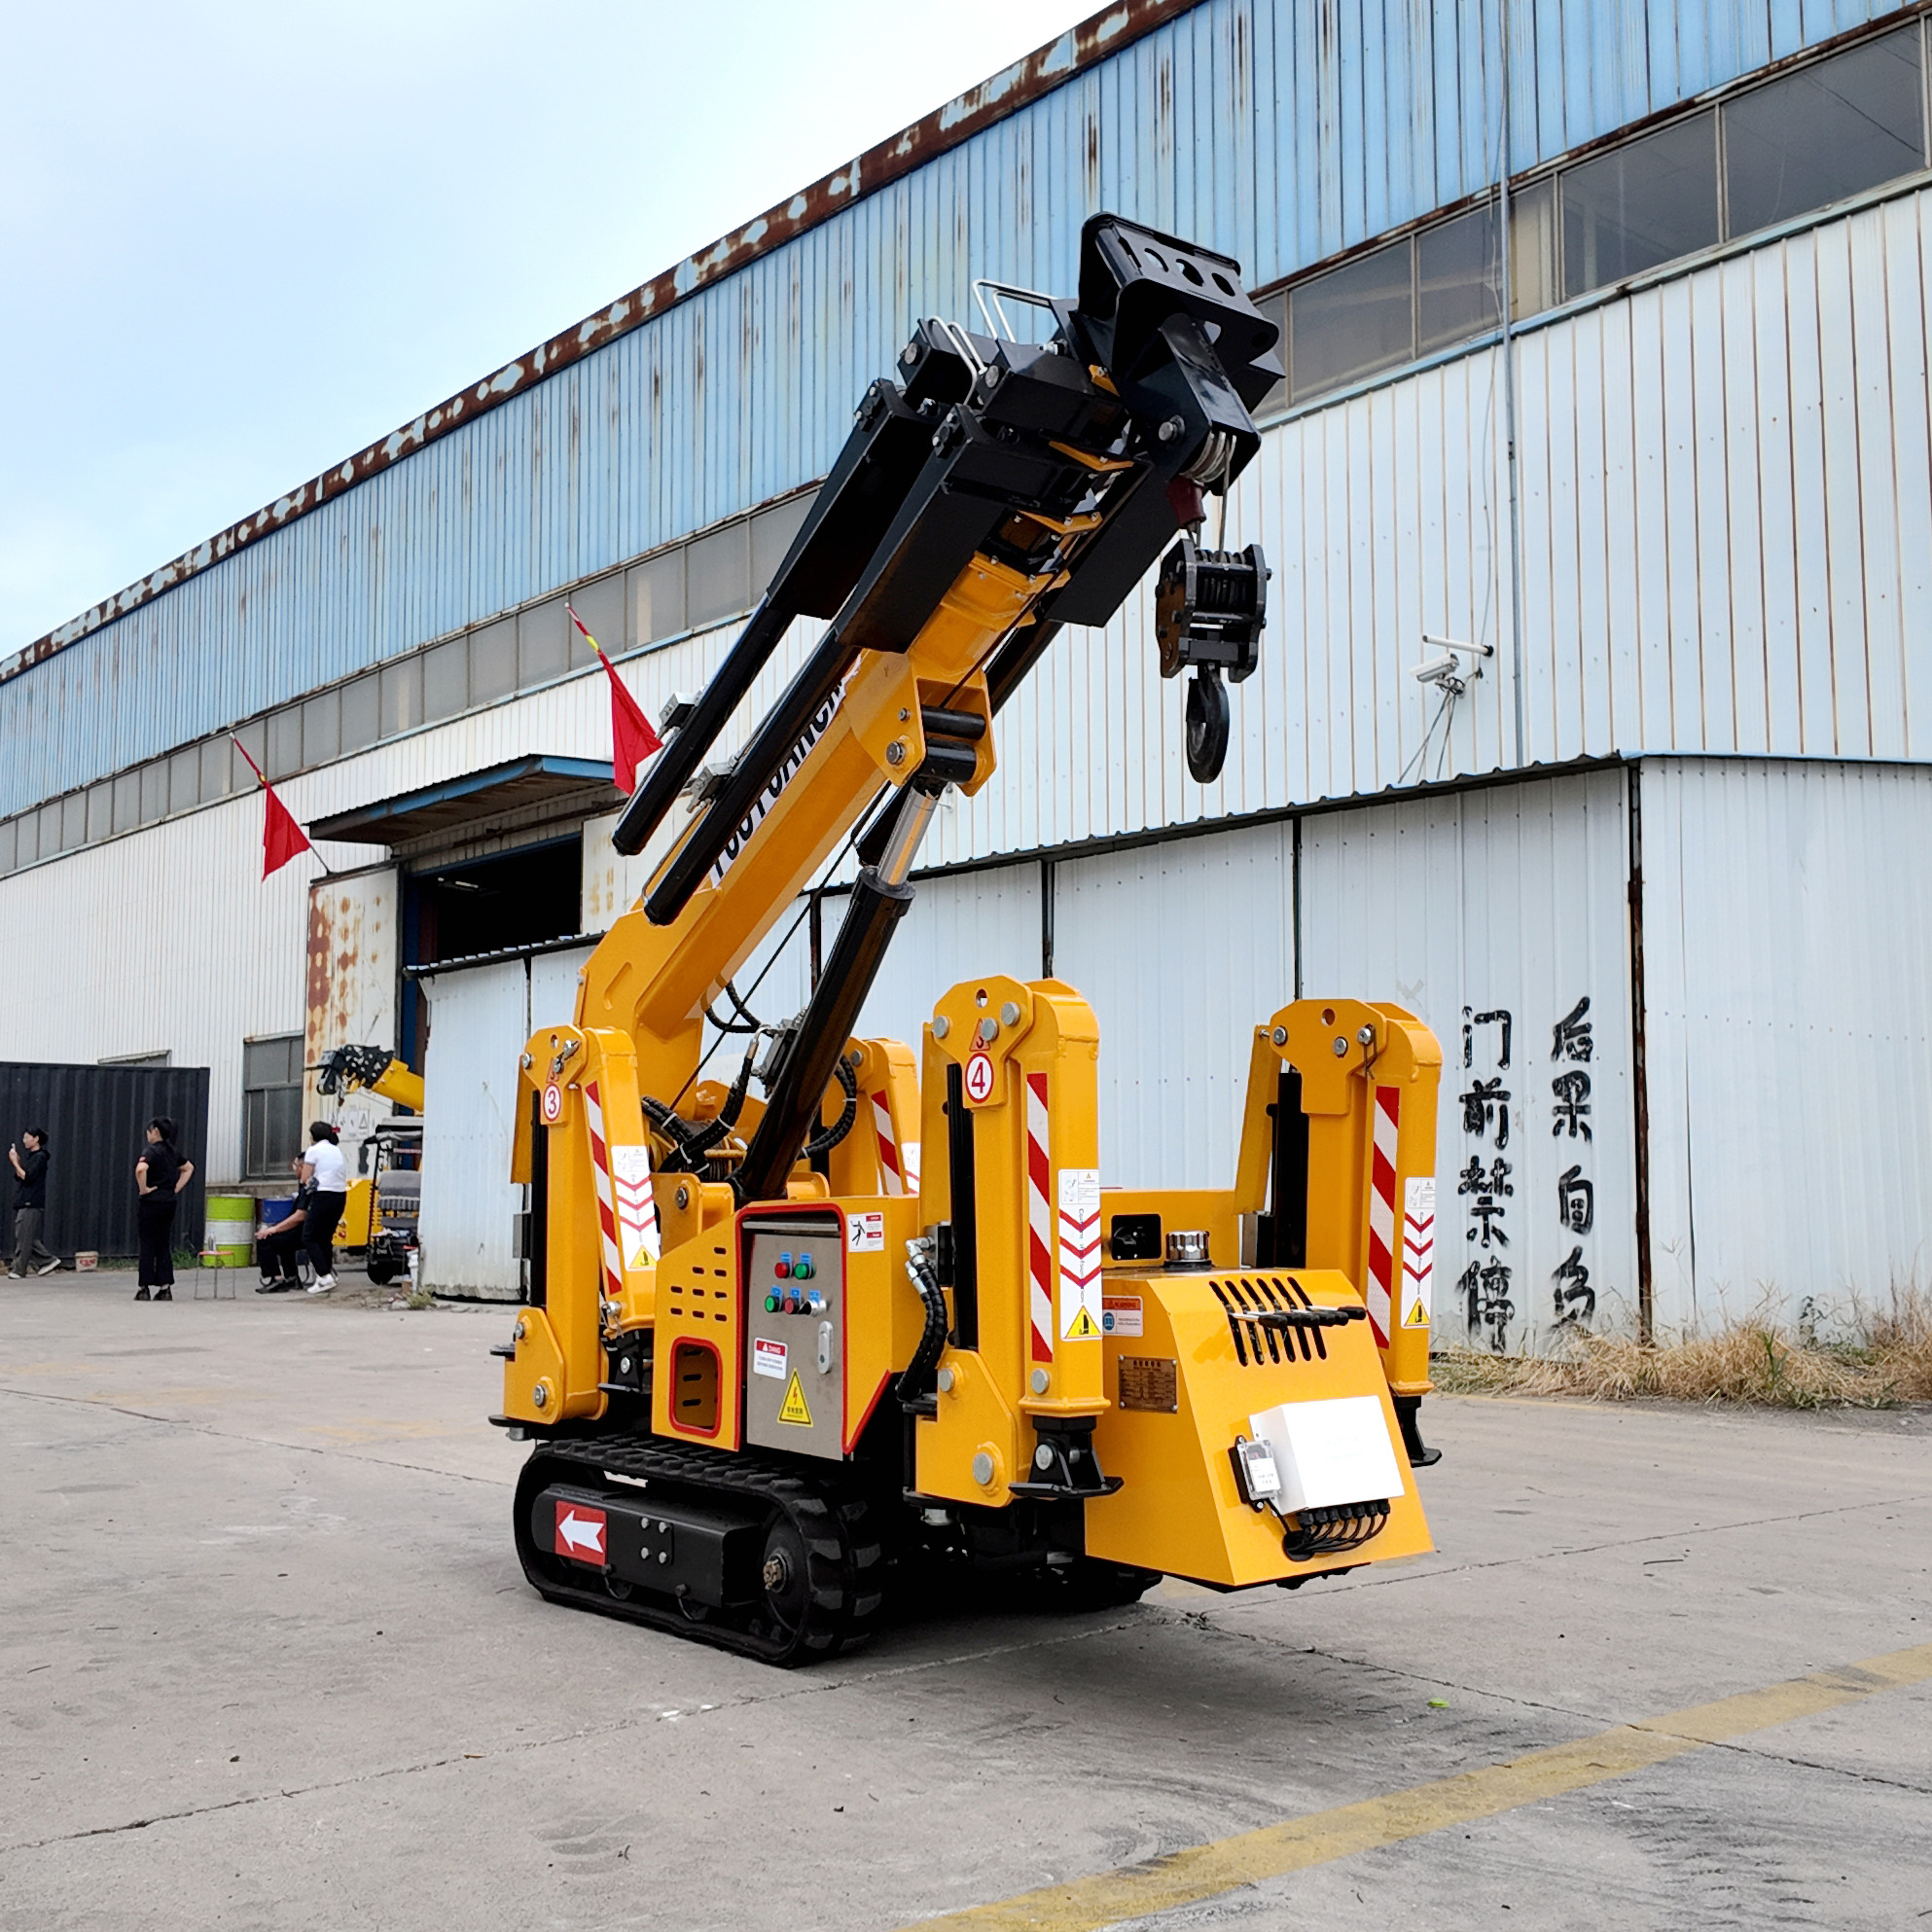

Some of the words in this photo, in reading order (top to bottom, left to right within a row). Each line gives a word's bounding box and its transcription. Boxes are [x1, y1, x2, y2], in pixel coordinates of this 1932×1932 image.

[548, 1090, 557, 1115] 3
[972, 1061, 985, 1093] 4
[1551, 996, 1595, 1336] 后果自负
[1457, 1005, 1515, 1352] 门前禁停
